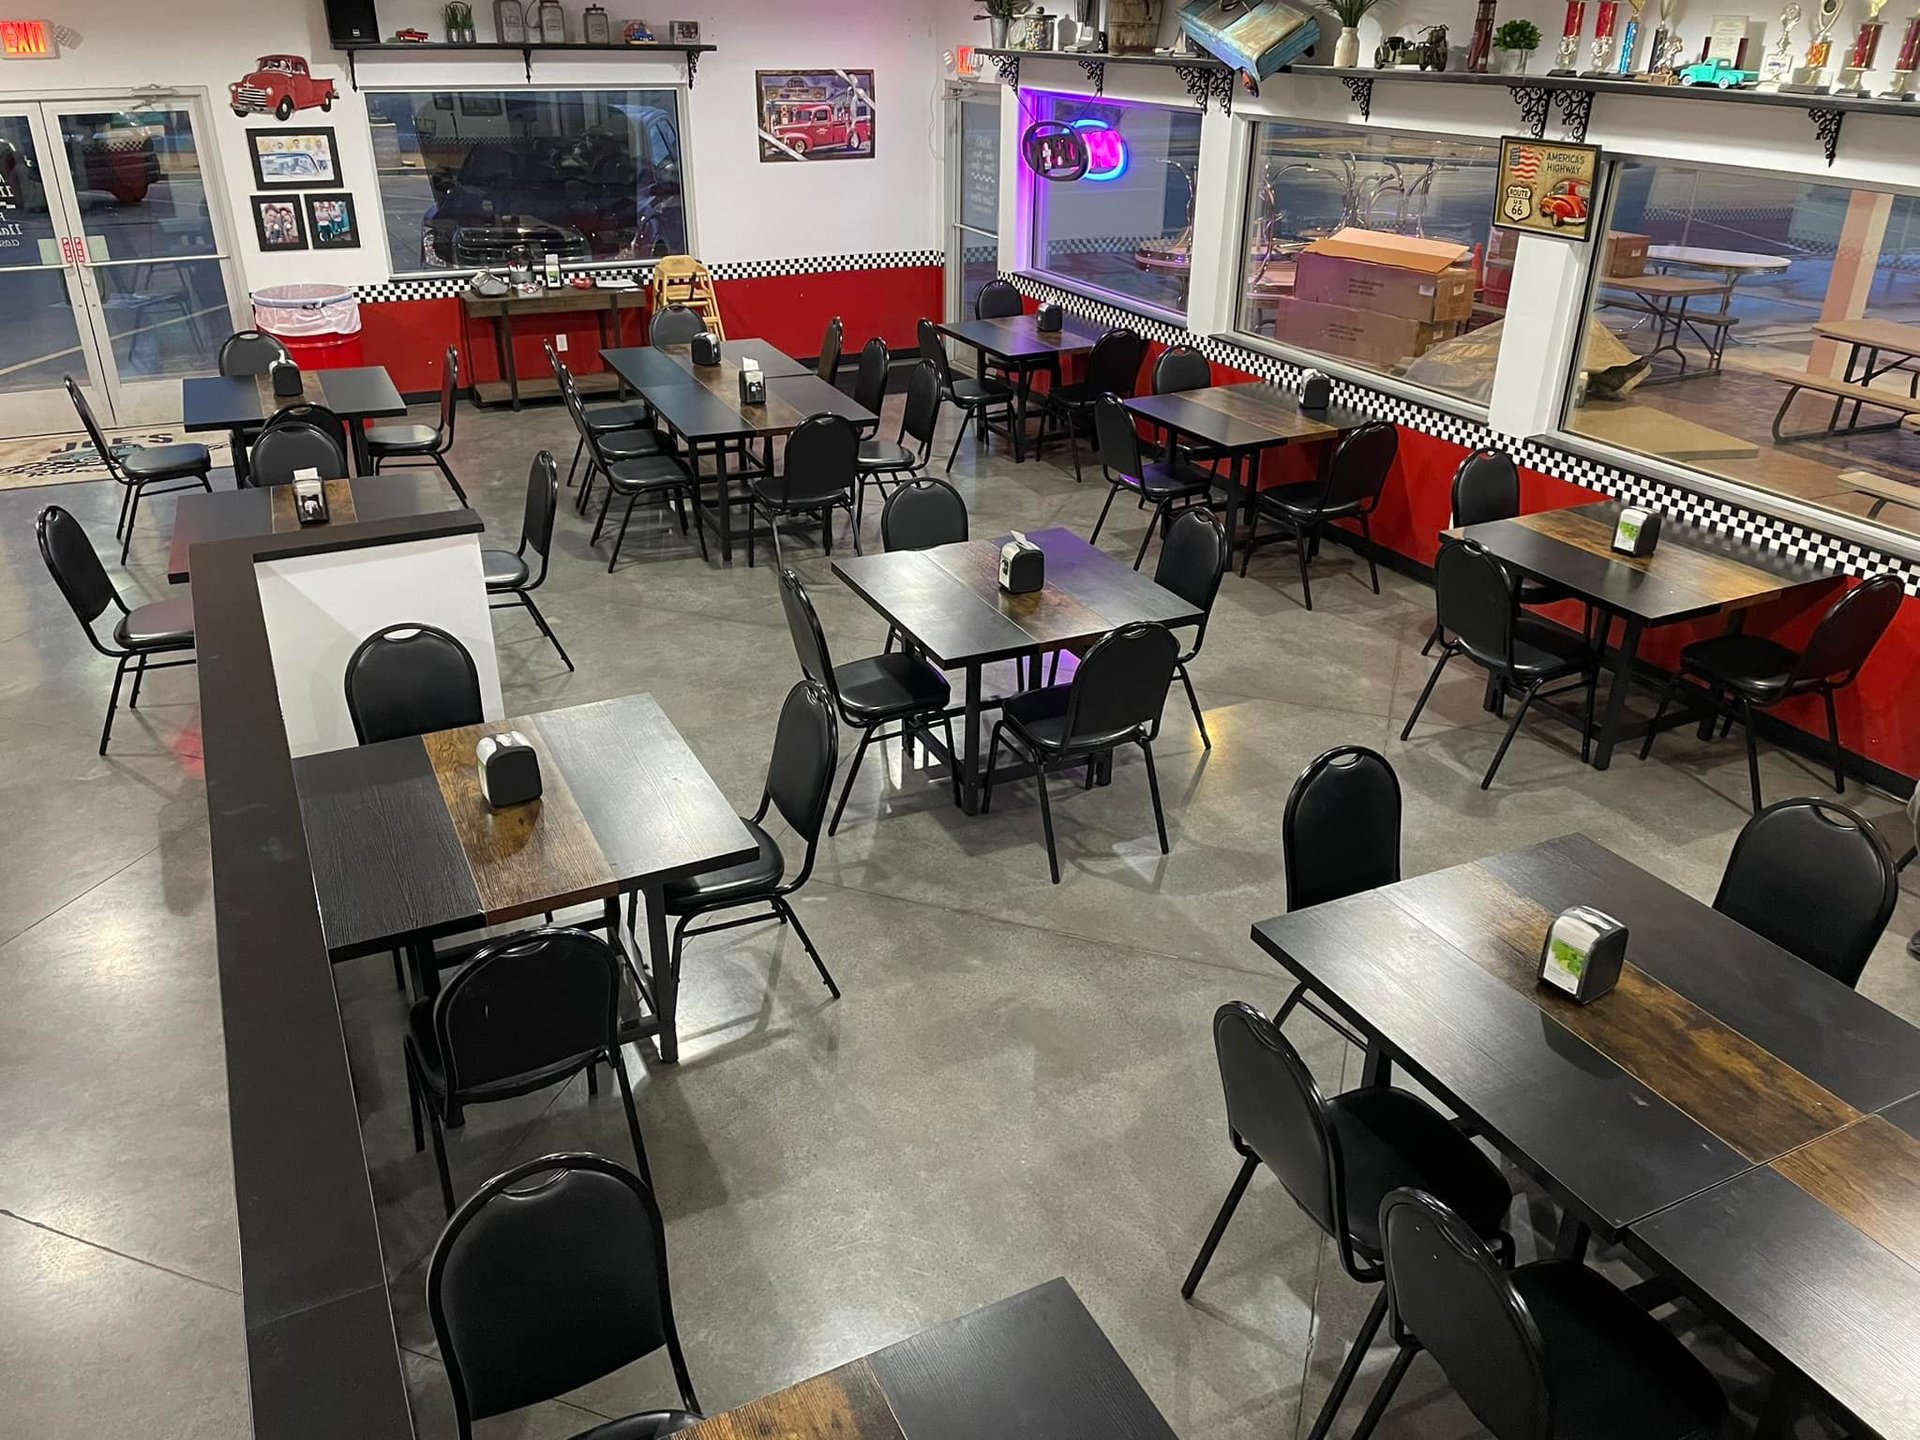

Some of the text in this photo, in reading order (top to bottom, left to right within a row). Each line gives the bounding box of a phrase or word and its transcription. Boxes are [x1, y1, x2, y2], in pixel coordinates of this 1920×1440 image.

[1, 21, 46, 53] EXIT
[1546, 151, 1585, 165] AMERICA'S
[1546, 162, 1581, 175] HIGHWAY
[1510, 188, 1529, 198] ROUTE
[1511, 204, 1523, 216] 66
[62, 237, 73, 263] PUSH
[74, 237, 85, 262] PUSH
